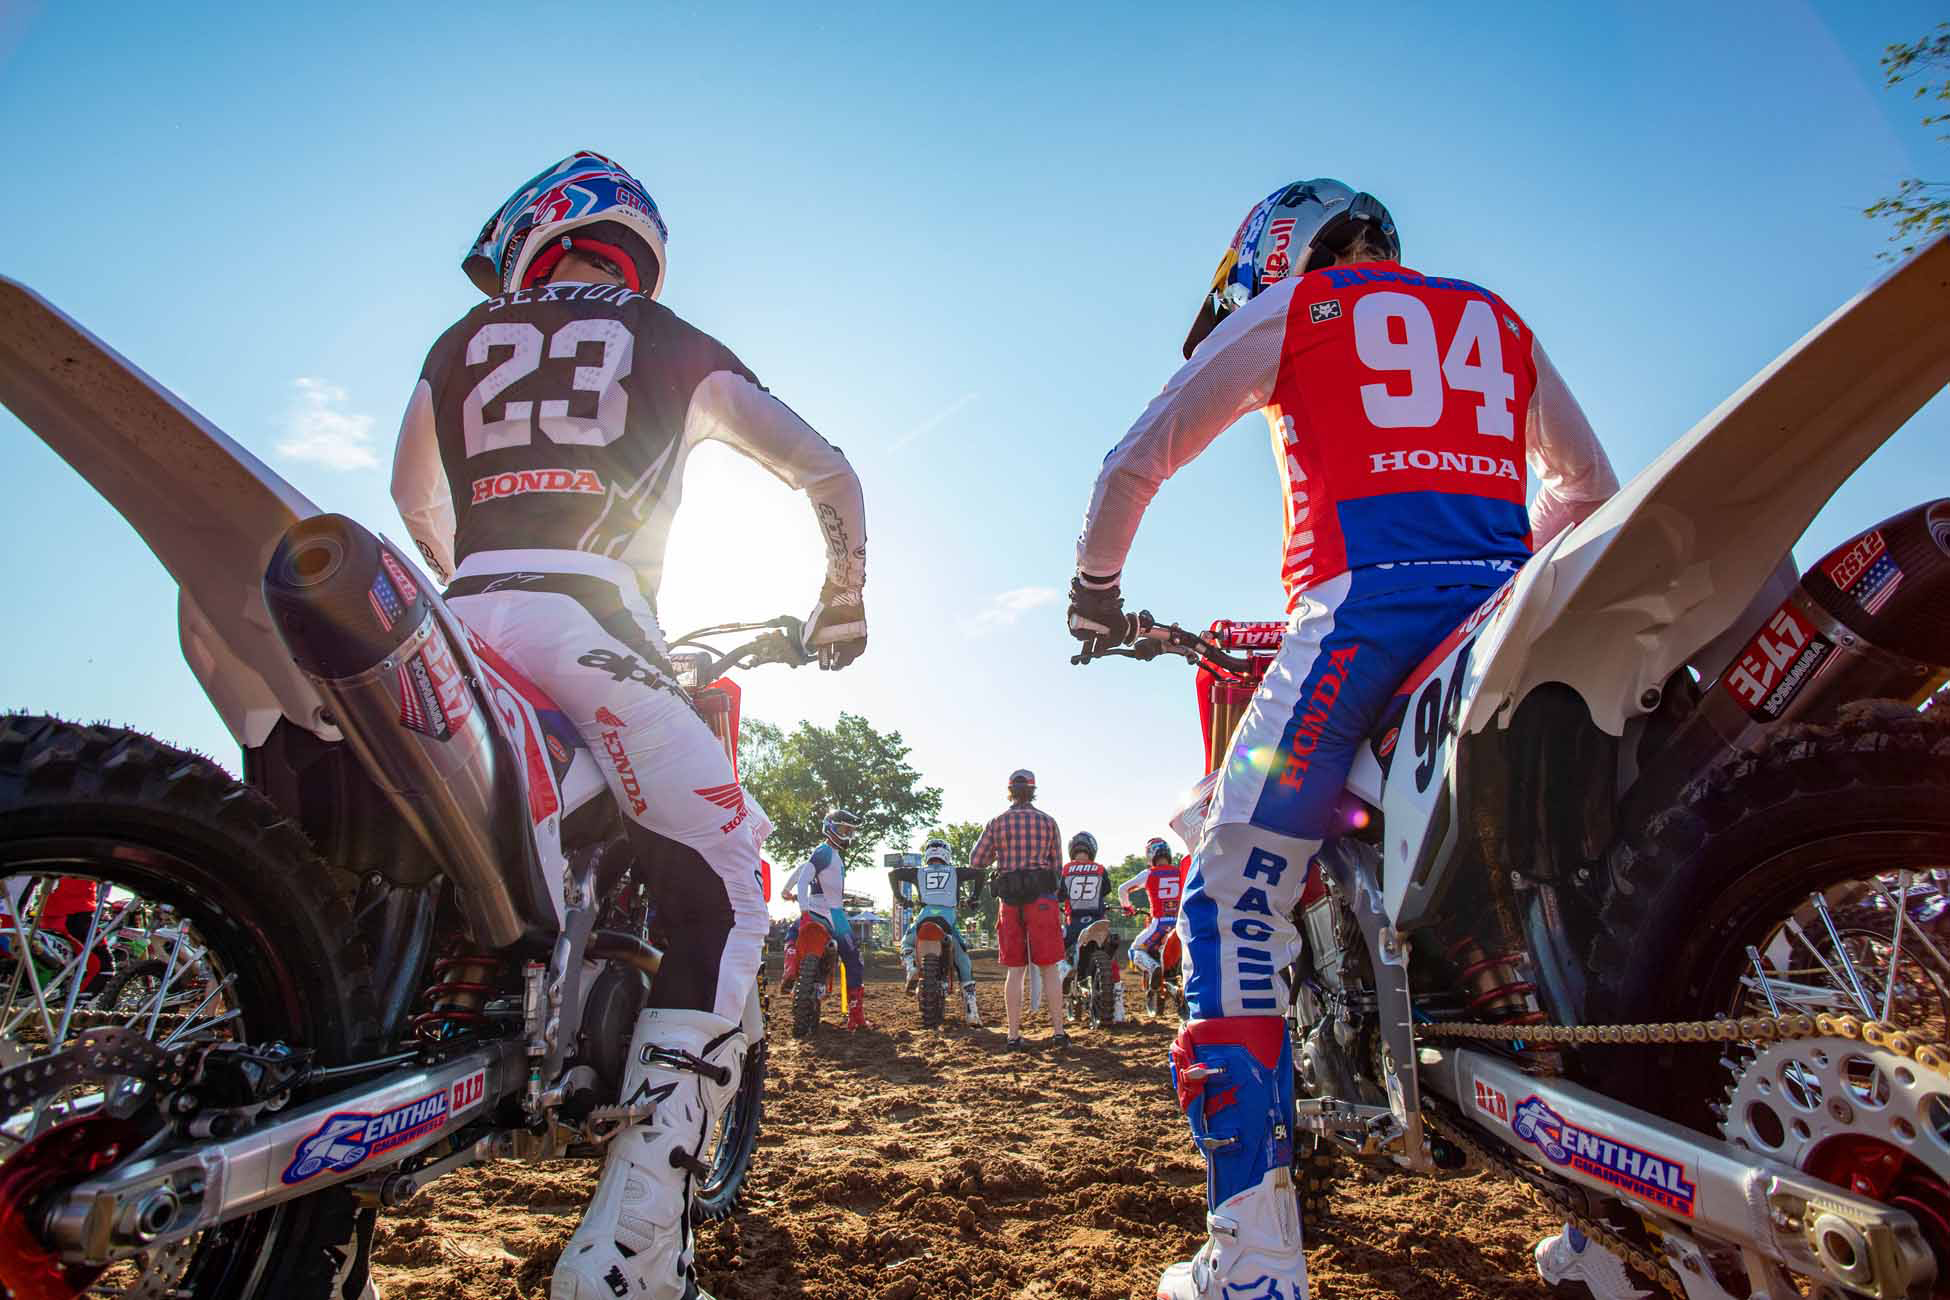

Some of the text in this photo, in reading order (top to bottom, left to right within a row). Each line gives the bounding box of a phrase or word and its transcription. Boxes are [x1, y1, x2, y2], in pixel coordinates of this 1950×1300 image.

[1265, 217, 1297, 277] Bull
[487, 283, 646, 312] SEXTON
[1353, 291, 1515, 441] 94
[463, 319, 635, 458] 23
[1369, 450, 1520, 481] HONDA
[472, 470, 605, 505] HONDA
[1763, 641, 1826, 714] YOSHIMURA
[1279, 644, 1360, 793] HONDA
[1415, 635, 1477, 794] 94
[720, 807, 752, 834] HON
[926, 871, 950, 889] 57
[1070, 876, 1100, 900] 63
[1157, 877, 1181, 899] 5
